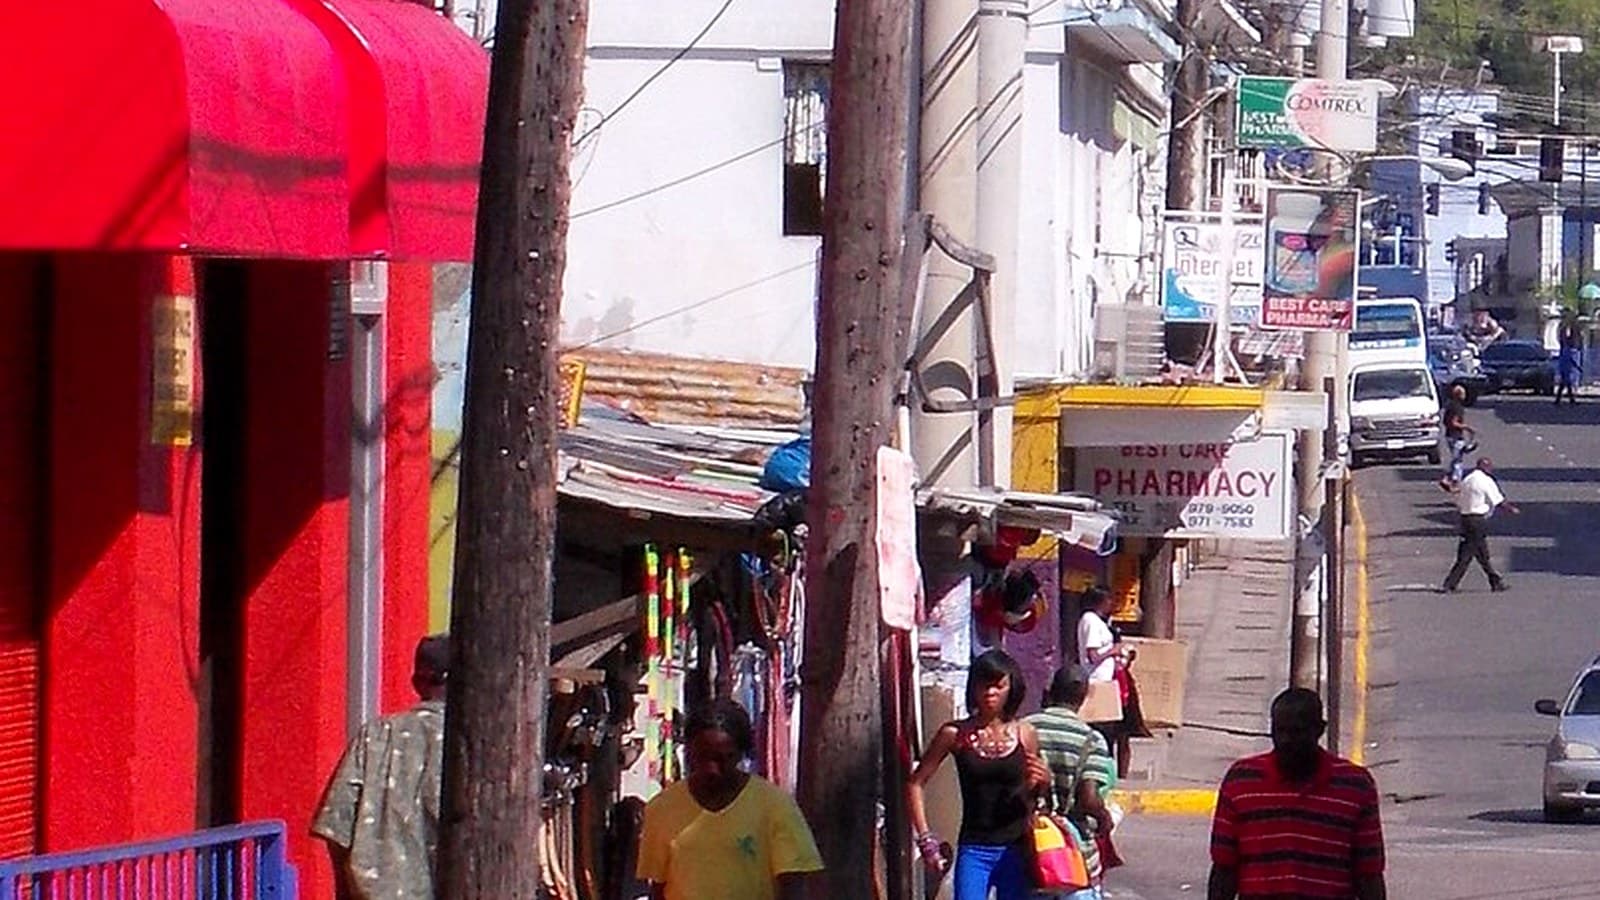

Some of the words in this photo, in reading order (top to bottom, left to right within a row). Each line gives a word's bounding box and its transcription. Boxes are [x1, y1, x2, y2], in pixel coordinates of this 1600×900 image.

[1286, 92, 1367, 113] COMTREX
[1174, 246, 1254, 277] Interet
[1269, 297, 1306, 311] BEST
[1121, 443, 1168, 458] BEST
[1179, 443, 1231, 459] CARE
[1094, 469, 1277, 496] PHARMACY
